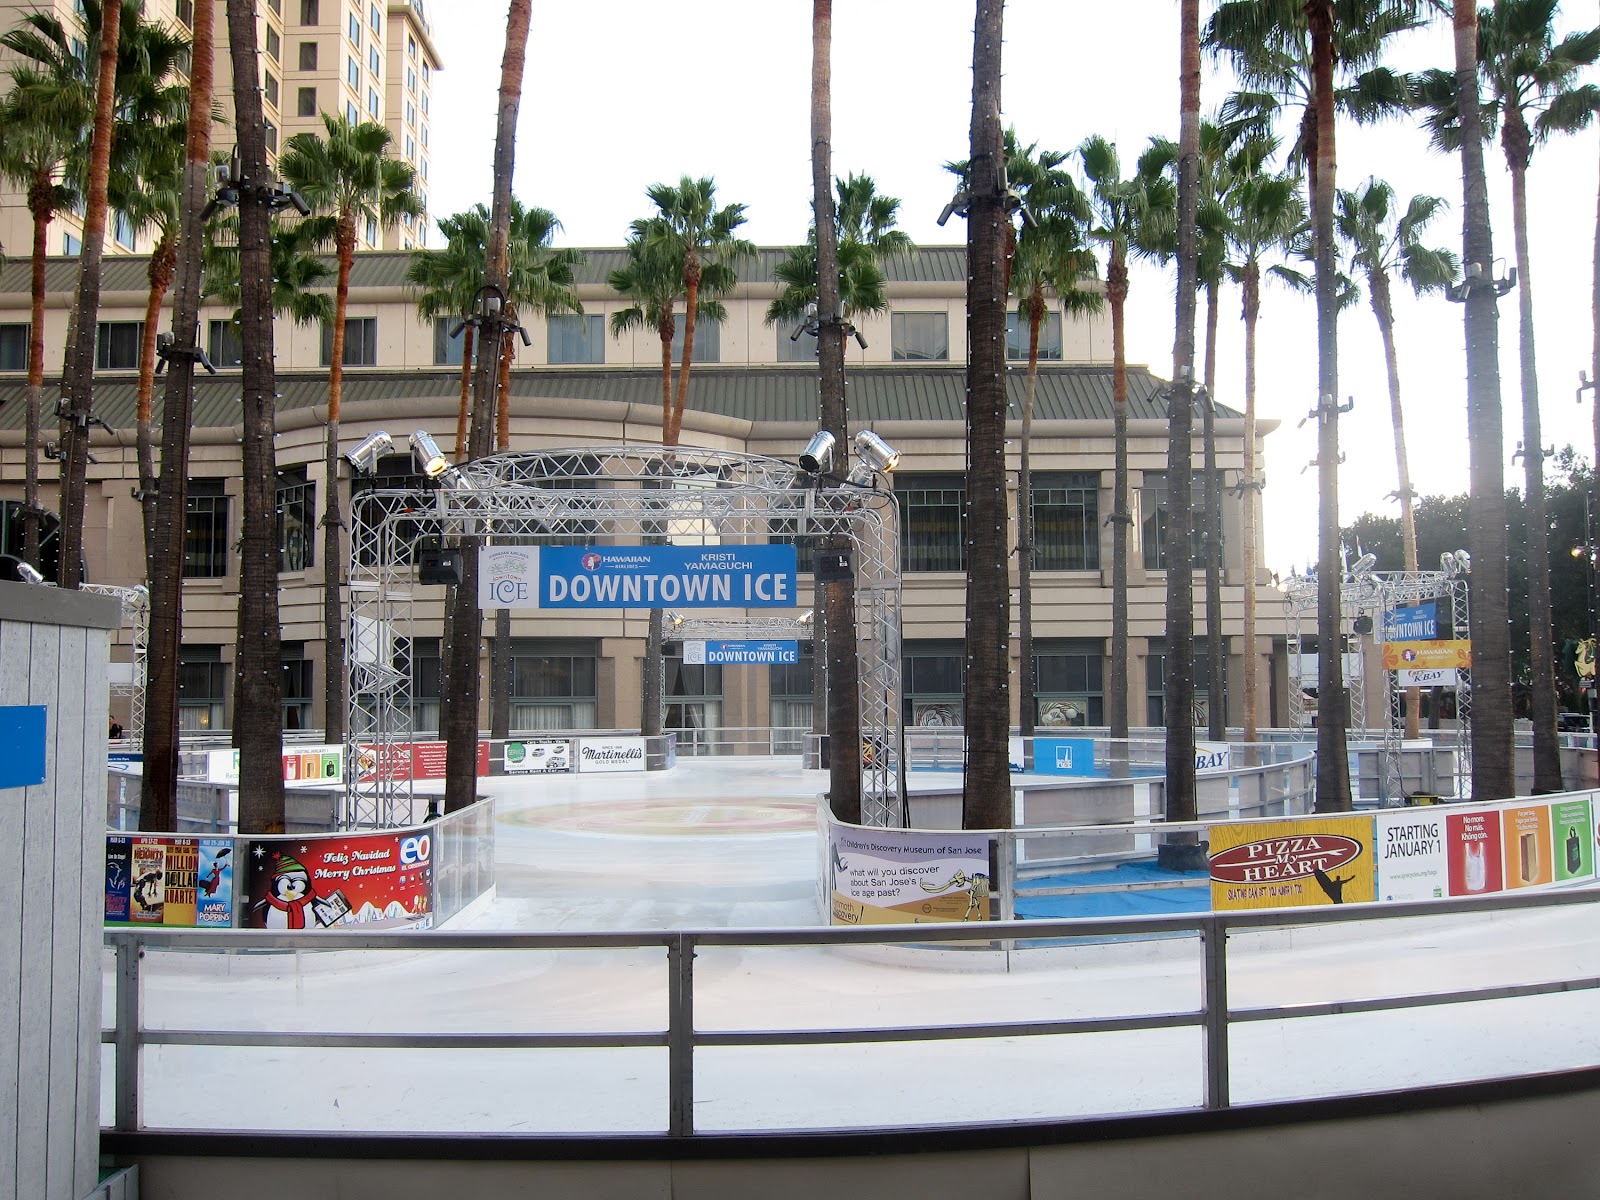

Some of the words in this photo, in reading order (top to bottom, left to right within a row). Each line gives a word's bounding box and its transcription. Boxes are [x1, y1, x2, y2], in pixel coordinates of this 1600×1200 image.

[602, 555, 651, 563] HAWAIIAN
[701, 553, 736, 561] KRISTI
[684, 561, 753, 570] YAMAGUCHI
[489, 579, 529, 604] ICE
[549, 574, 731, 602] DOWNTOWN
[744, 573, 787, 601] ICE
[1424, 619, 1435, 636] ICE
[708, 651, 775, 662] DOWNTOWN
[778, 651, 795, 662] ICE
[581, 746, 643, 760] Martinelli's
[1463, 816, 1470, 824] No
[1387, 823, 1439, 842] STARTING
[846, 840, 870, 850] Children's
[870, 843, 902, 854] Discovery
[903, 846, 935, 854] Museum
[1247, 837, 1322, 859] PIZZA
[1384, 840, 1434, 859] JANUARY
[1437, 840, 1441, 853] 1
[134, 850, 164, 860] HEIGHTS
[323, 852, 349, 864] Feliz
[351, 848, 391, 861] Navidad
[1275, 854, 1299, 865] My
[166, 855, 198, 870] MILLION
[314, 868, 350, 880] Merry
[352, 865, 396, 877] Christmas
[881, 869, 897, 877] you
[899, 866, 940, 875] discover
[1243, 858, 1328, 882] HEART
[850, 879, 869, 887] about
[870, 878, 887, 886] San
[889, 878, 917, 886] Jose's
[164, 889, 197, 904] QUARTET
[862, 890, 875, 898] age
[877, 888, 901, 897] past?
[204, 904, 226, 912] MARY
[199, 913, 230, 921] POPPINS
